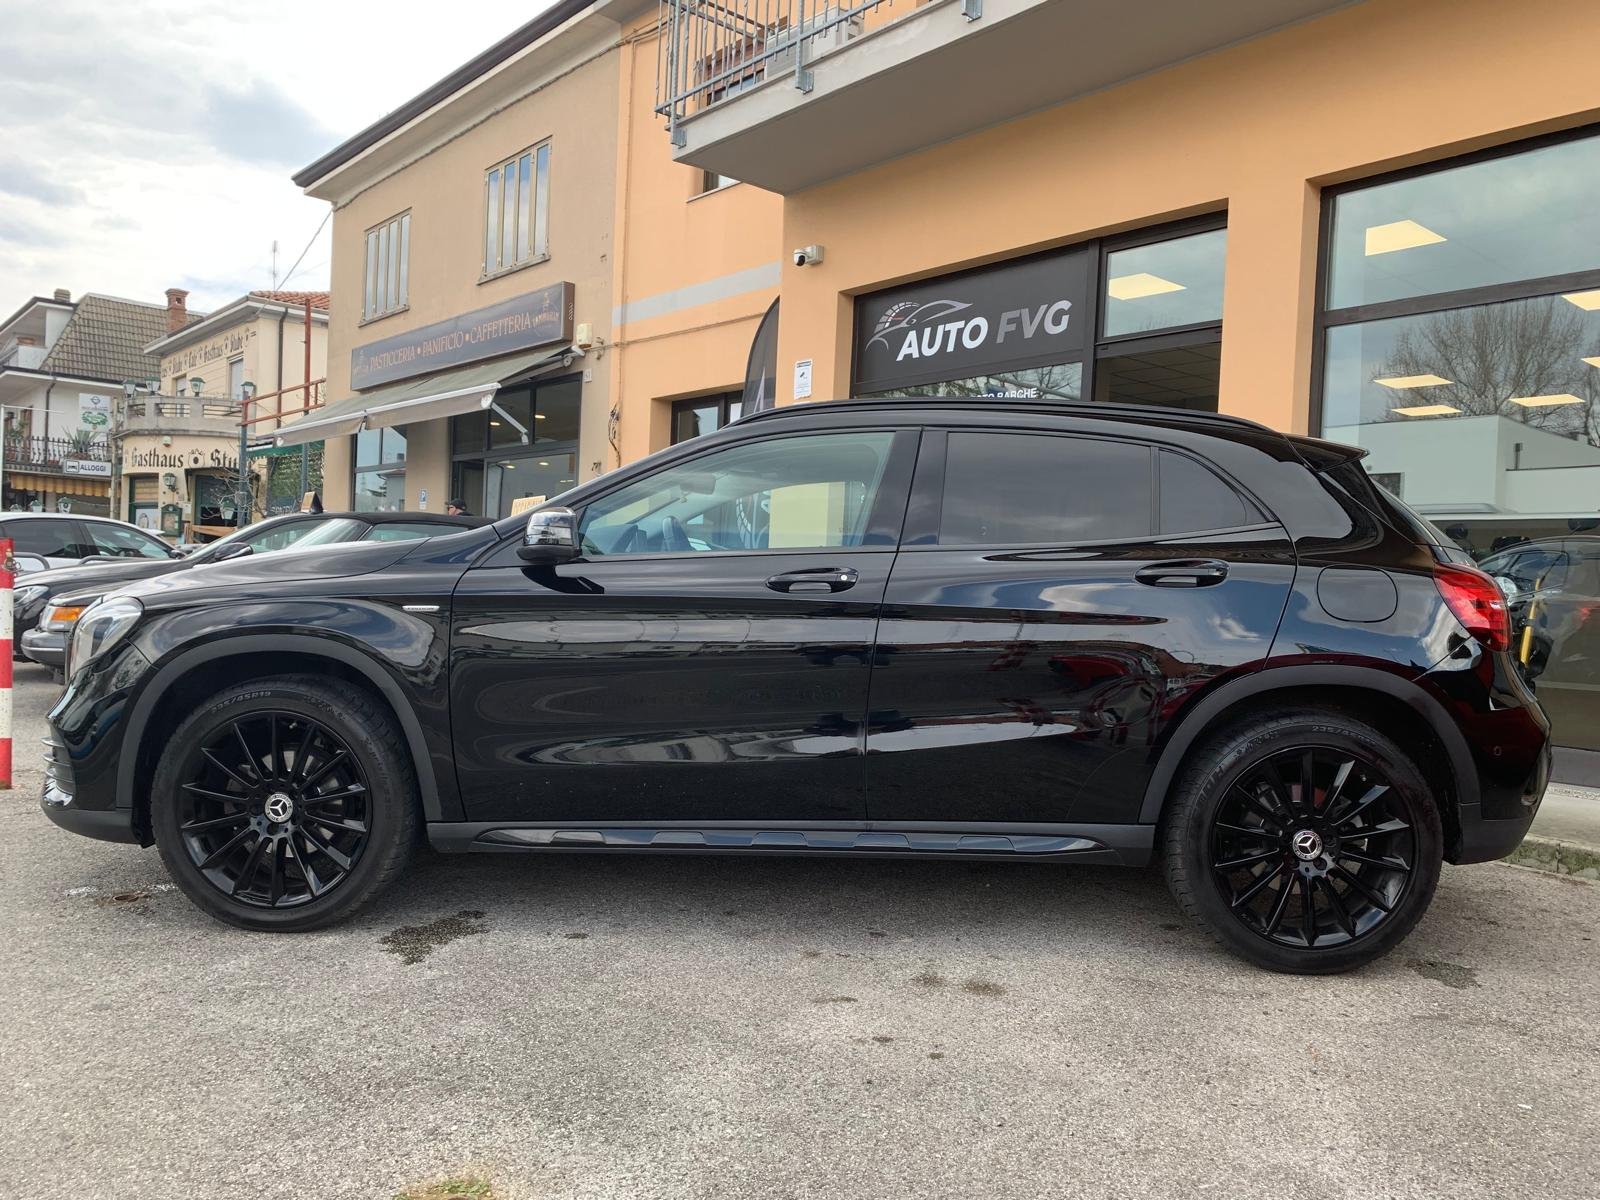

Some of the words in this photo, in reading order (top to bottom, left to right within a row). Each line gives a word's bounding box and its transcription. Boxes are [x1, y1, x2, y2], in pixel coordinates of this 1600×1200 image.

[369, 345, 416, 372] PASTICCERIA
[422, 331, 464, 357] PANIFICIO
[470, 311, 531, 344] CAFFETTERIA
[896, 316, 989, 362] AUTO
[996, 299, 1072, 344] FVG
[80, 464, 107, 472] ALLOGGI
[131, 446, 184, 468] Gasthaus
